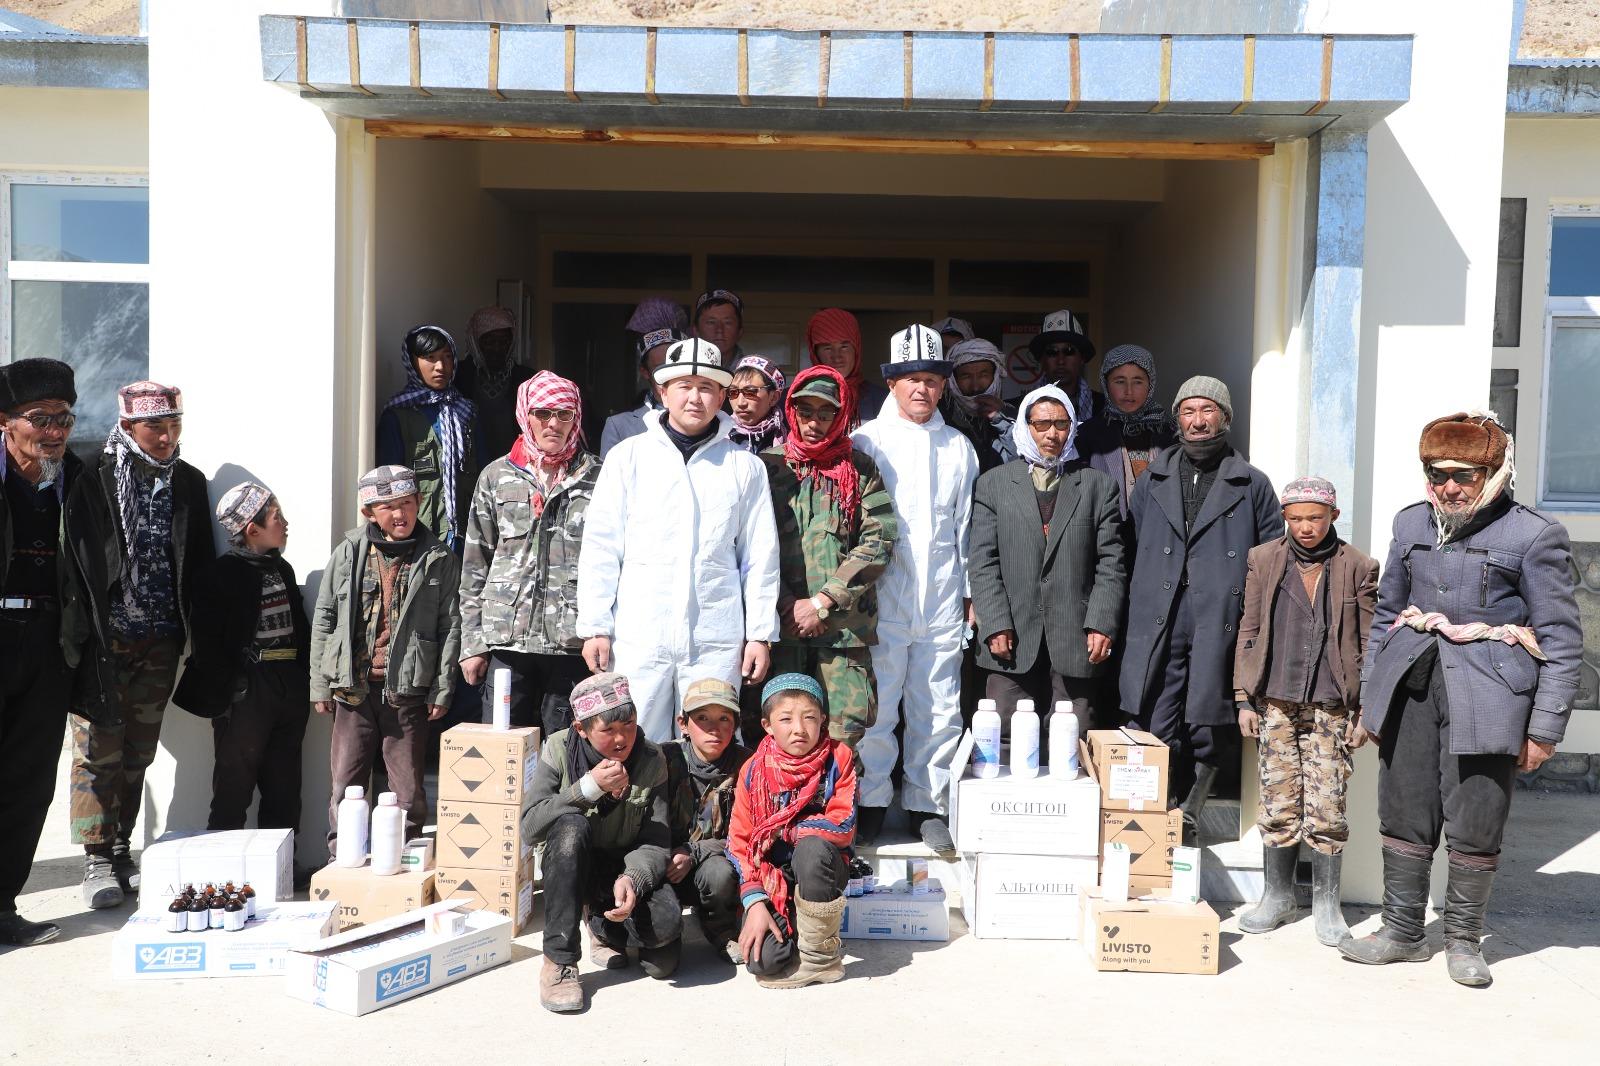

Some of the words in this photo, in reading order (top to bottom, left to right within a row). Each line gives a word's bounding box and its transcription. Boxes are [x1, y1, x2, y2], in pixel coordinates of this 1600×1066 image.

[1010, 324, 1041, 333] NOTIC
[1102, 942, 1152, 954] LIVISTO
[1102, 956, 1122, 964] Along
